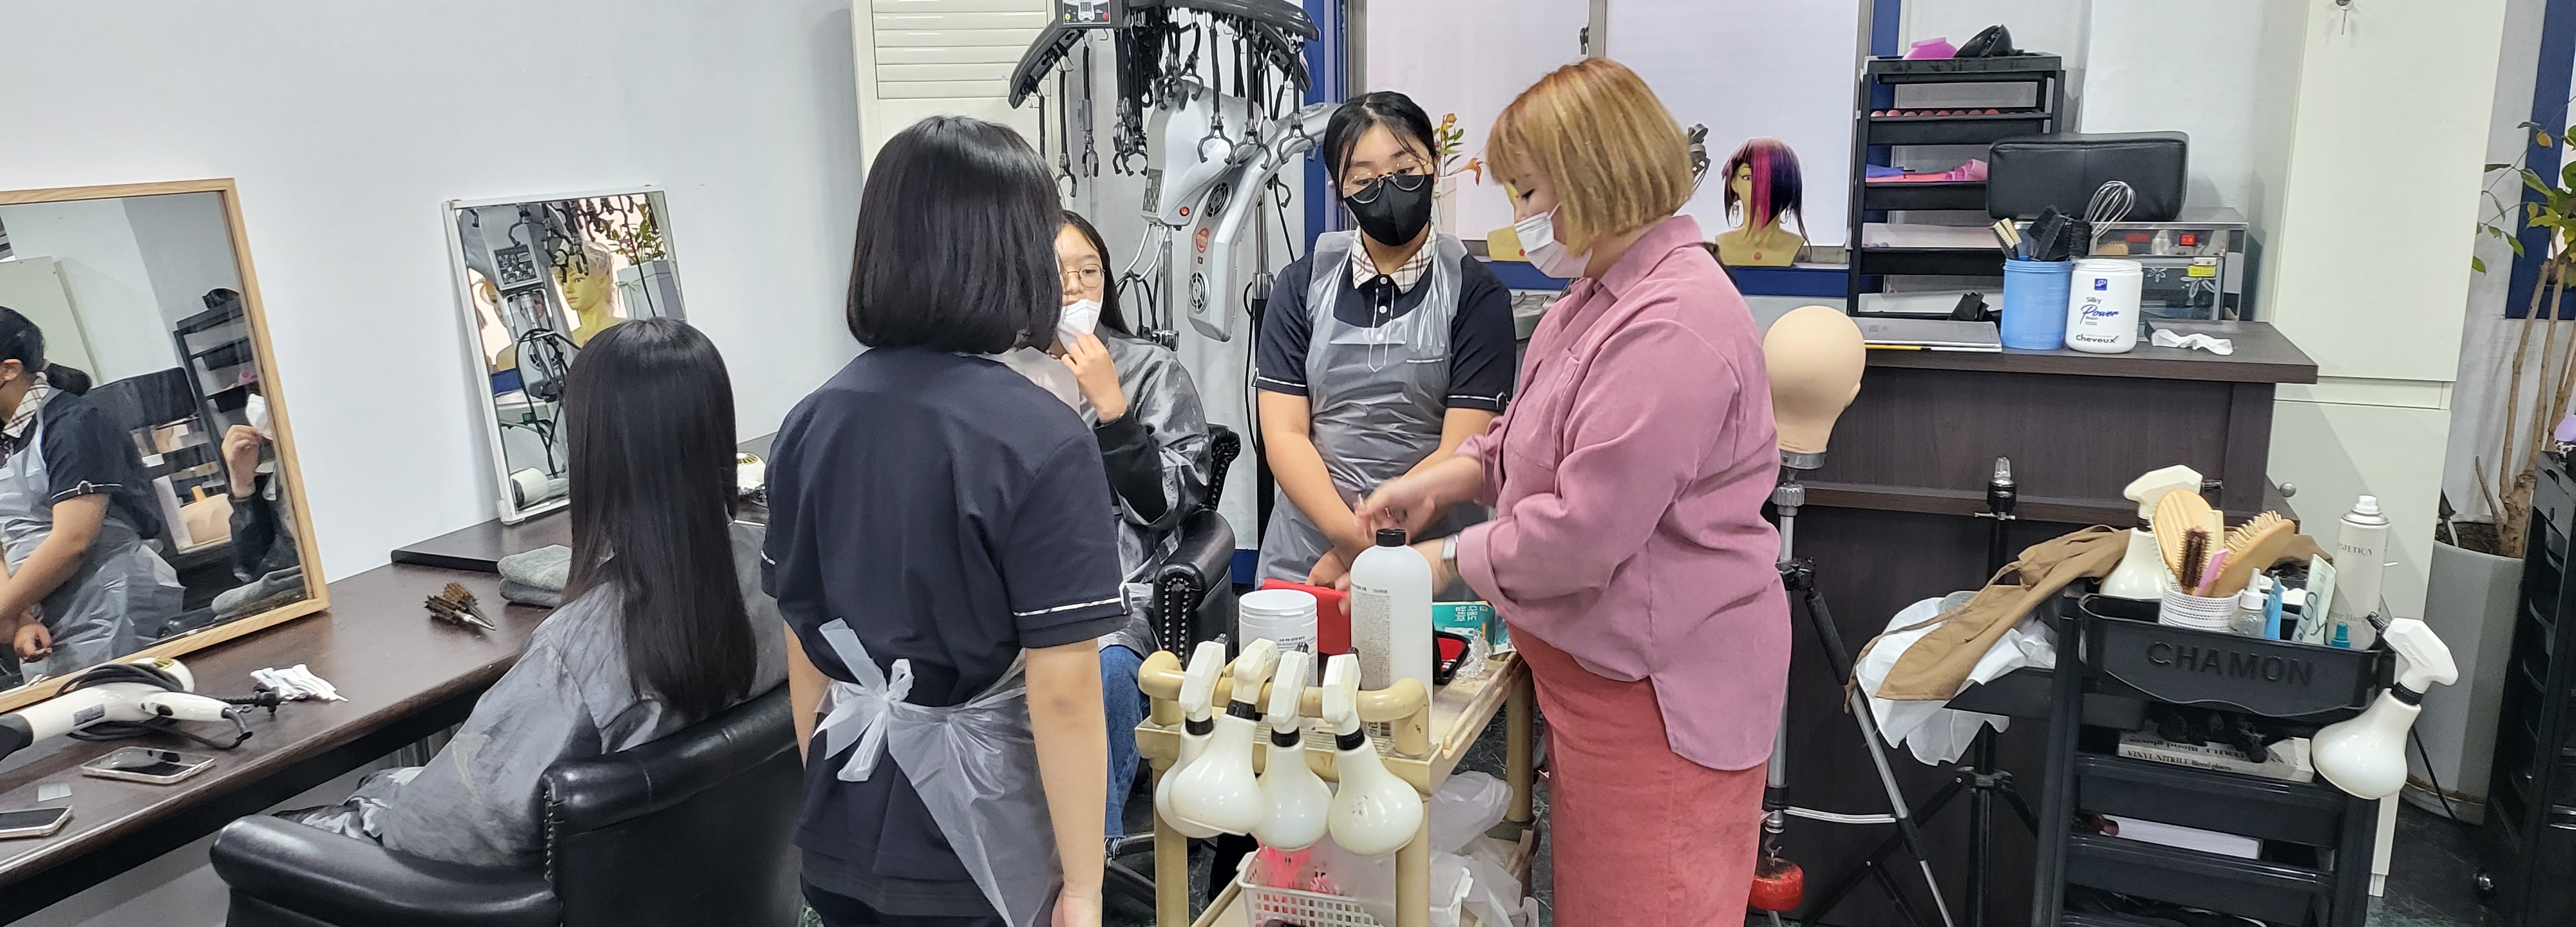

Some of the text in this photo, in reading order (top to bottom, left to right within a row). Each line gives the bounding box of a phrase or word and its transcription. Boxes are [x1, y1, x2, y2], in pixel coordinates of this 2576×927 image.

[2079, 304, 2119, 325] Power
[1466, 606, 1478, 621] 다용도
[2346, 613, 2365, 622] Hard
[2146, 642, 2313, 687] CHAMON
